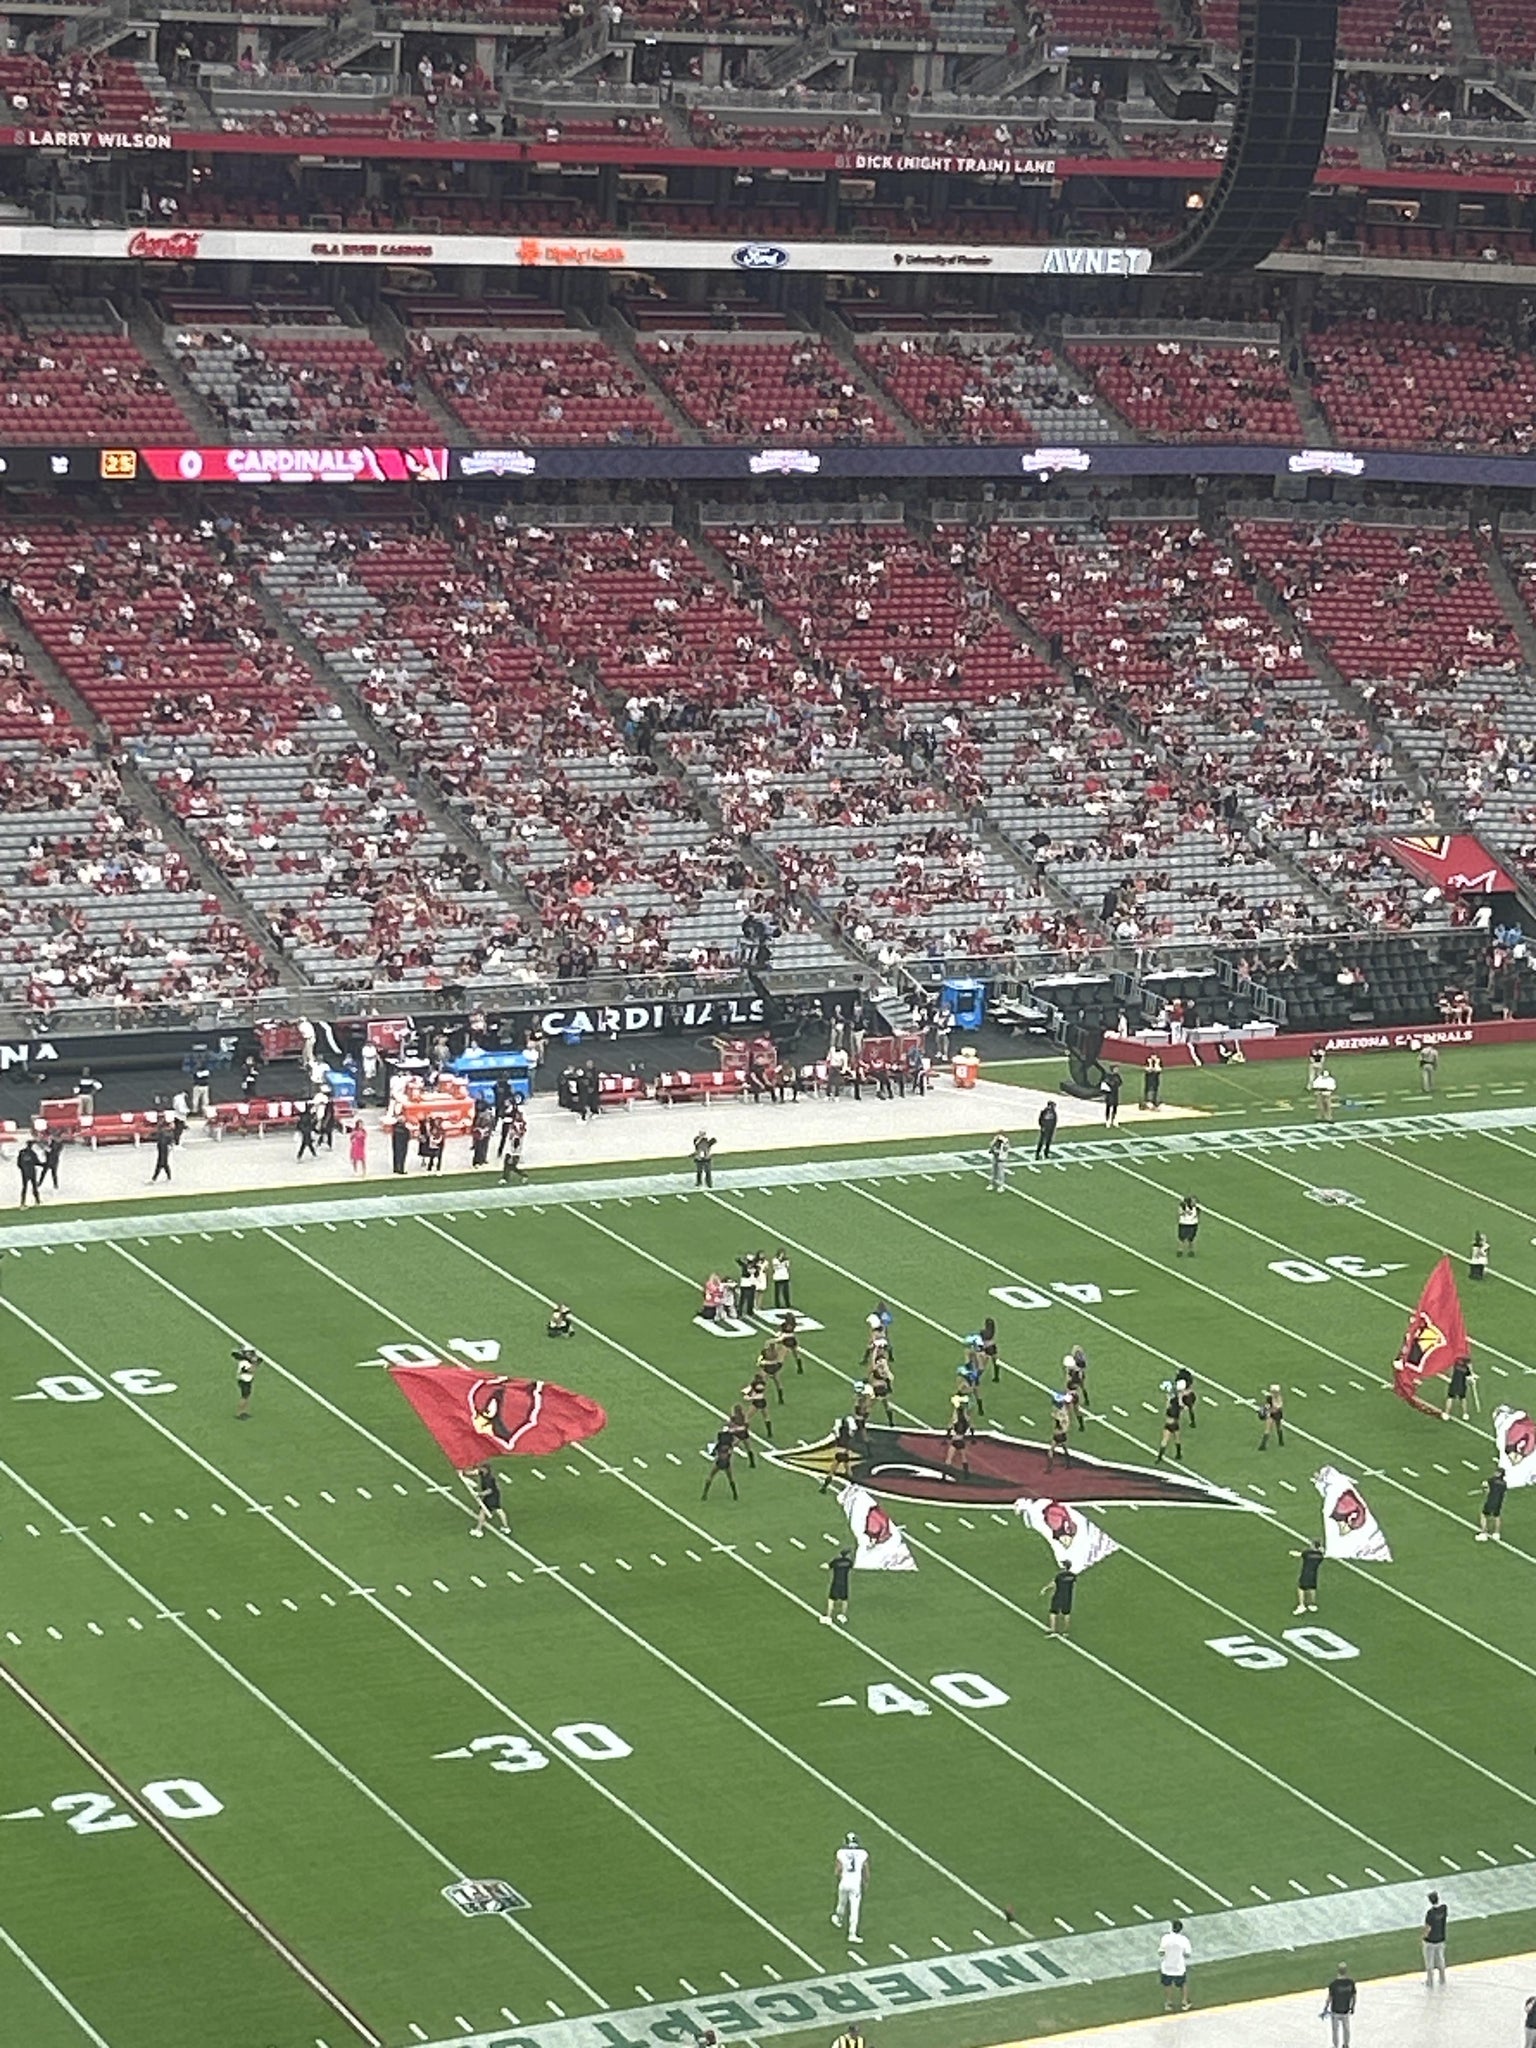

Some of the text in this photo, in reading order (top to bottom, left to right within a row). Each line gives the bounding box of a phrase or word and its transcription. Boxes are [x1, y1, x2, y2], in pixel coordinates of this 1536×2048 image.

[29, 131, 92, 146] LARRY
[98, 133, 172, 148] WILSON
[855, 154, 893, 169] DICK
[897, 156, 951, 172] (NIGHT
[956, 158, 1010, 174] TRAIN)
[1043, 248, 1140, 273] AVNET
[226, 450, 366, 472] CARDINALS
[1325, 1036, 1389, 1050] ARIZONA
[593, 1948, 1070, 2048] INTERCEPT
